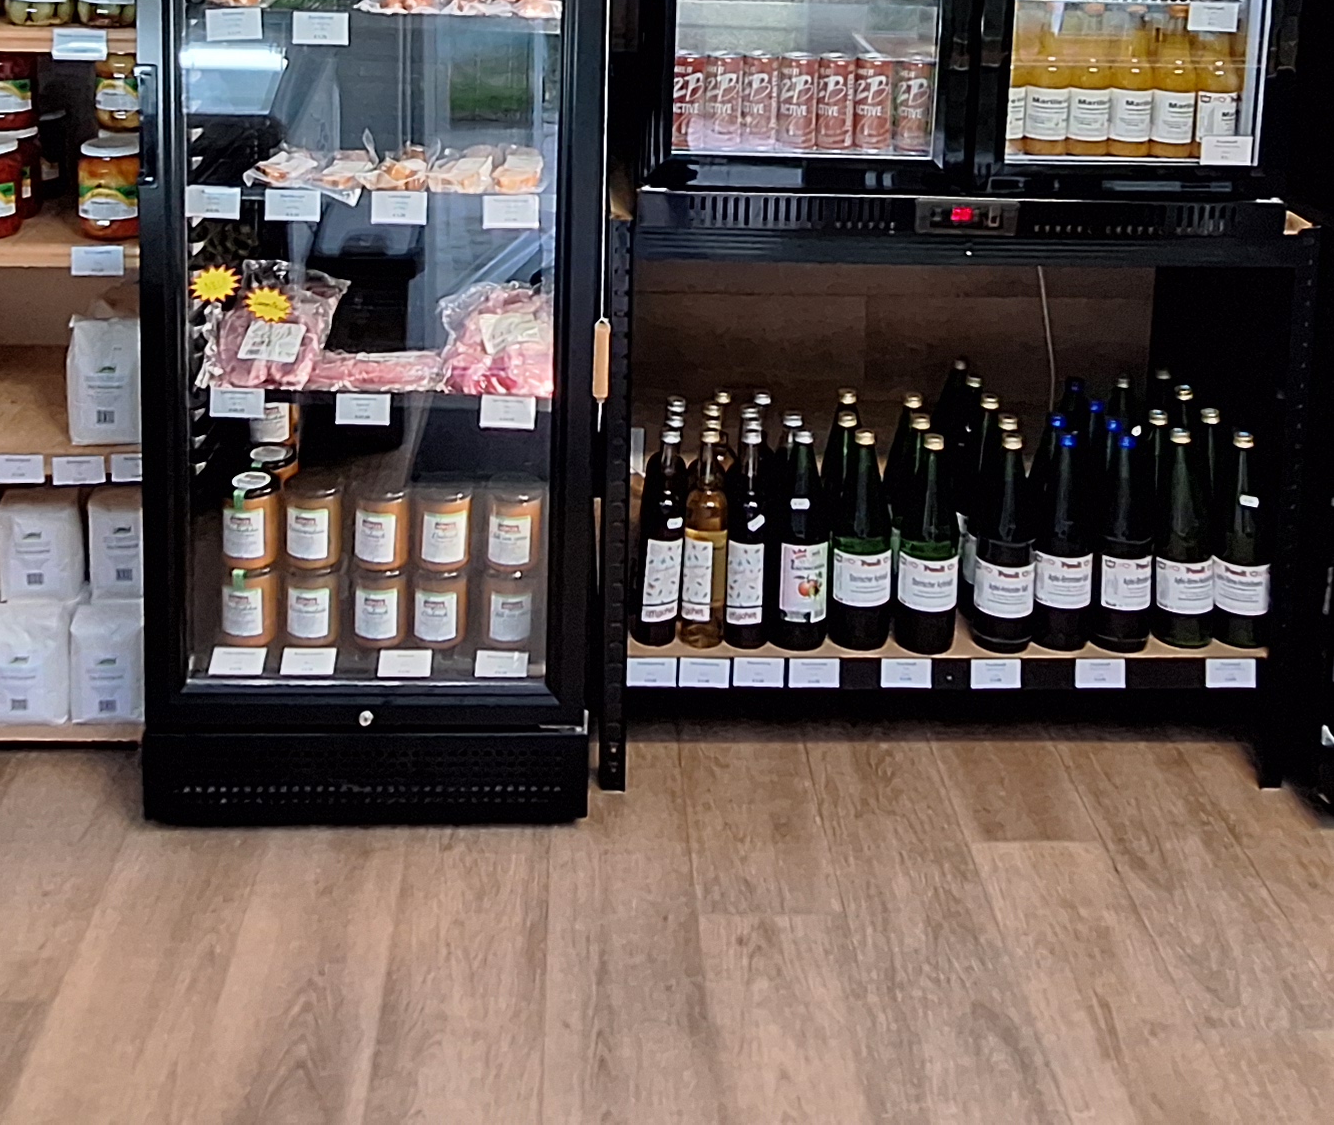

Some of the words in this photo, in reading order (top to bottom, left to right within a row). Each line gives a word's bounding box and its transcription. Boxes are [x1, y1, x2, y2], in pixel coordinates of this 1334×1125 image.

[673, 72, 704, 102] 2B
[707, 73, 738, 102] 2B
[780, 75, 813, 103] 2B
[855, 75, 888, 104] 2B
[897, 78, 929, 106] 2B
